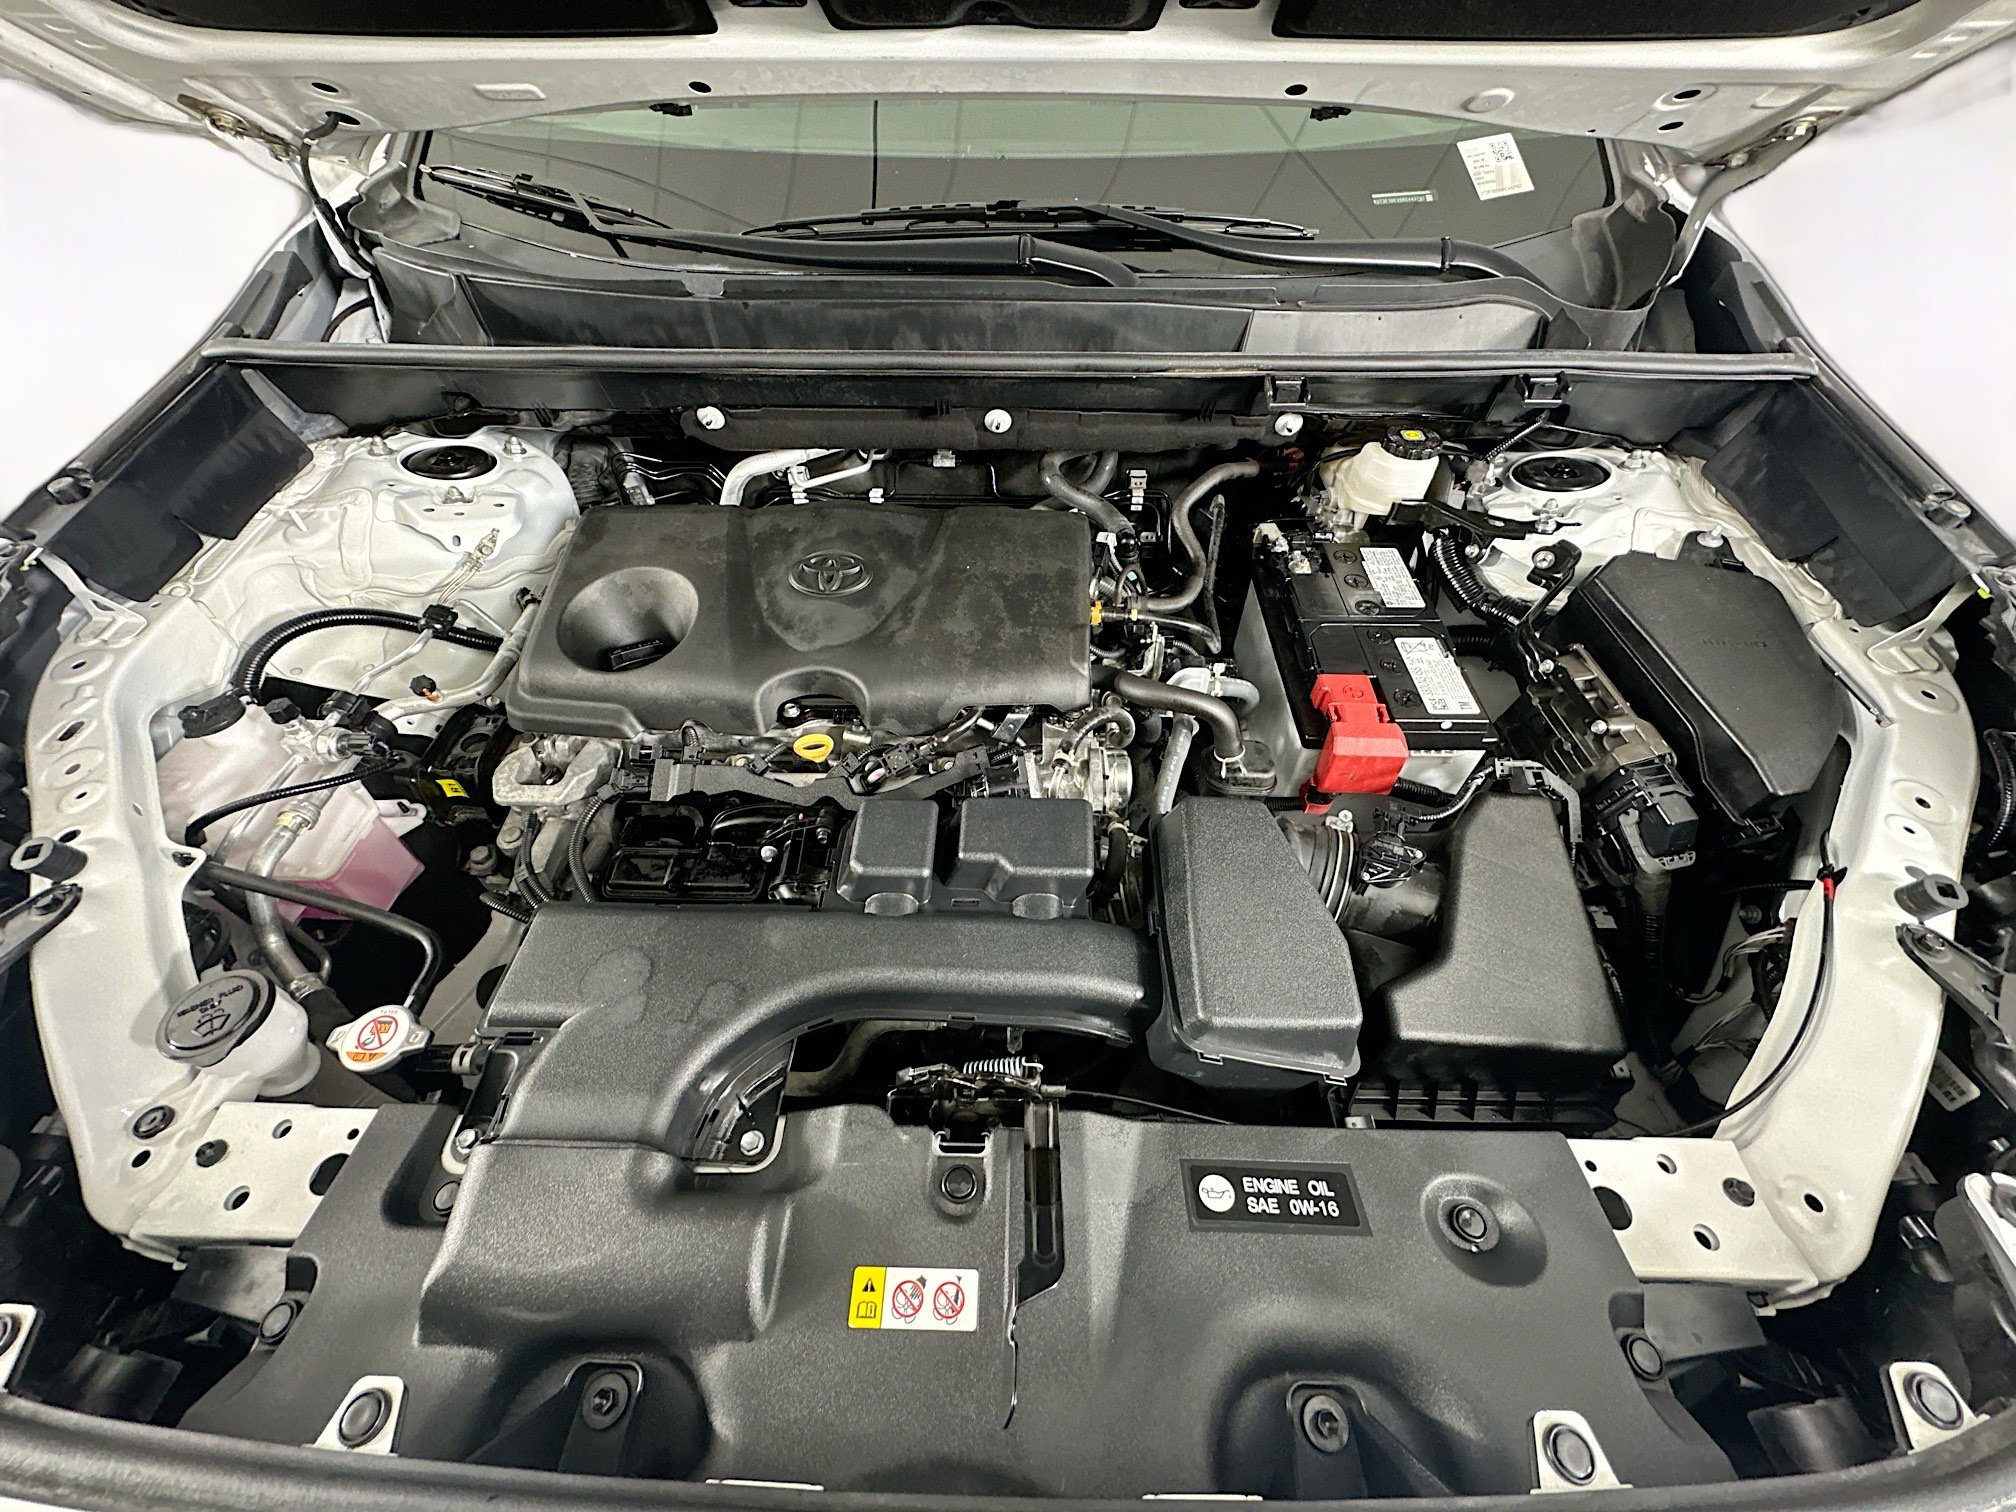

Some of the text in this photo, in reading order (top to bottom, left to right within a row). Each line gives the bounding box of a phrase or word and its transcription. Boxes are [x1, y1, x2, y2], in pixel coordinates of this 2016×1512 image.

[1242, 1176, 1336, 1197] ENGINE OIL
[1246, 1197, 1340, 1218] SAE 0W-16
